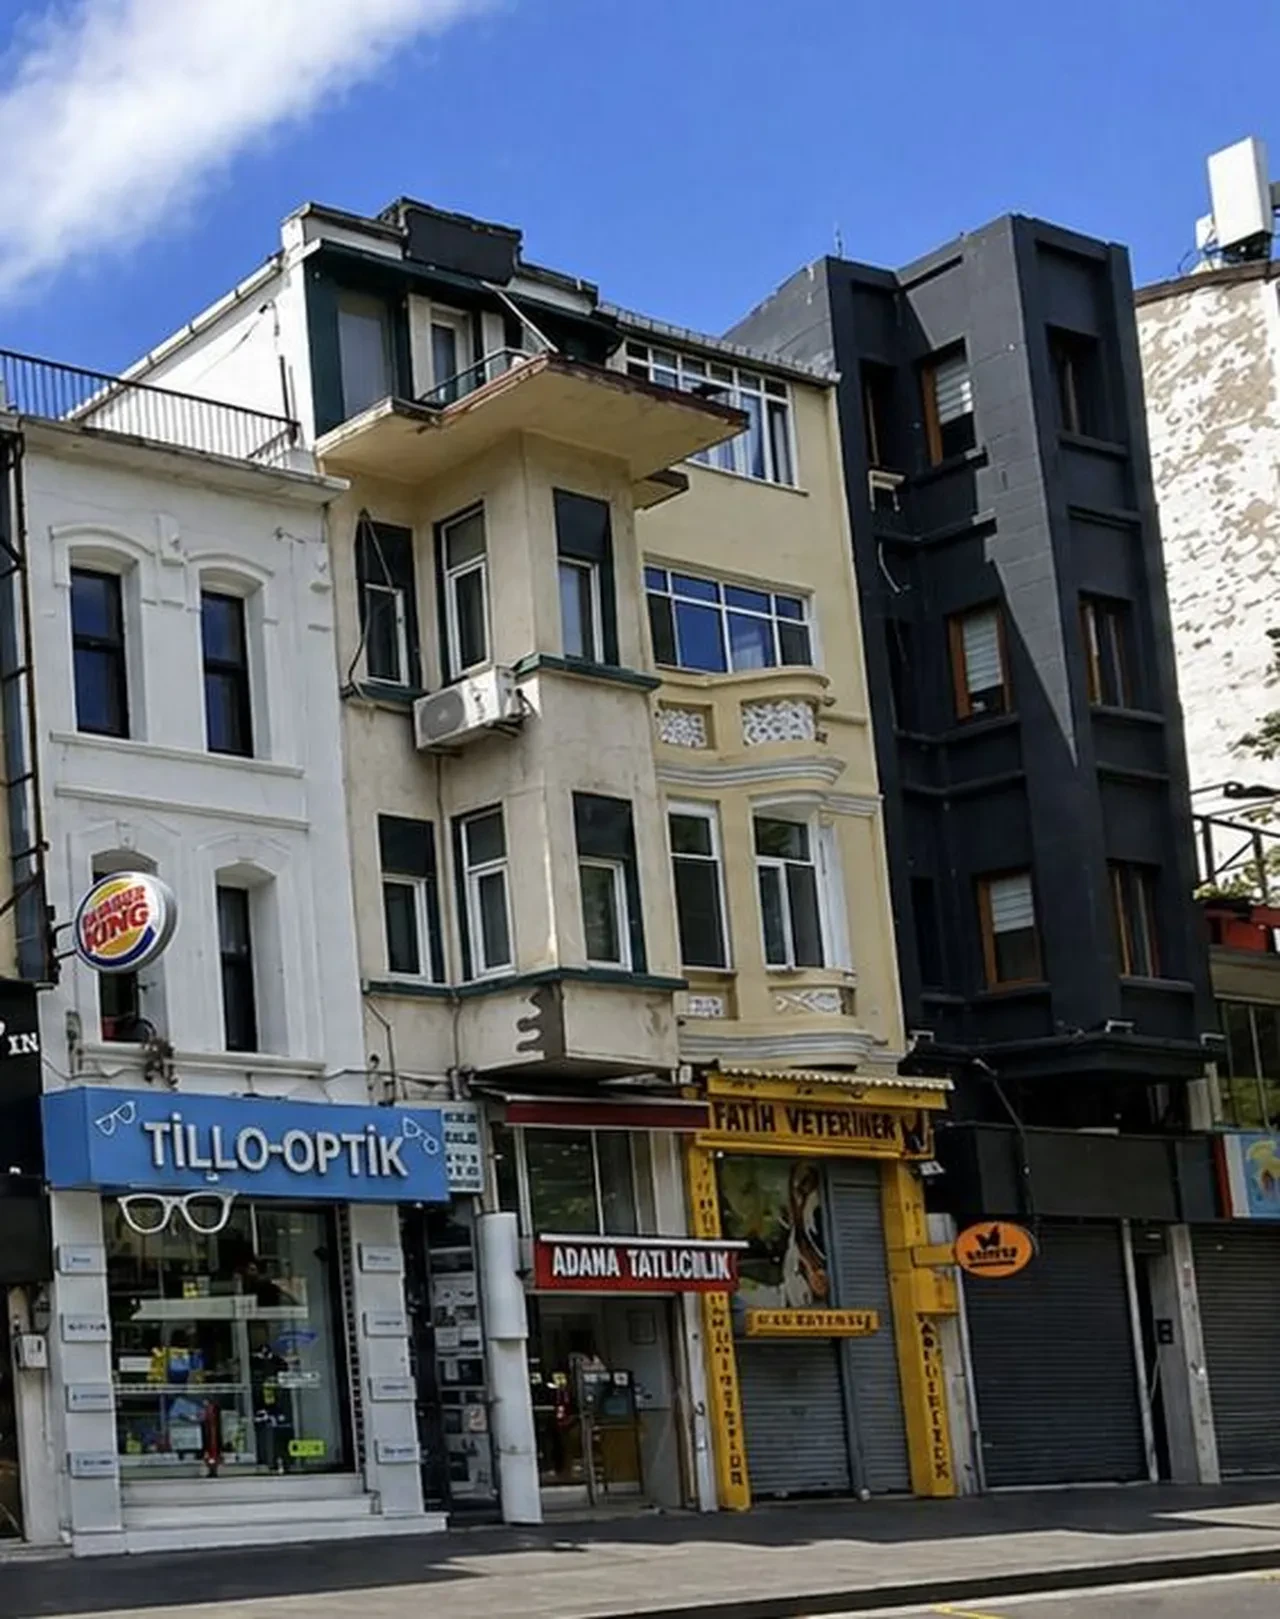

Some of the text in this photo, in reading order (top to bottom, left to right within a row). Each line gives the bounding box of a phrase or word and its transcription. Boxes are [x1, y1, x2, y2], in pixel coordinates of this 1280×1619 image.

[84, 903, 149, 953] KING
[144, 1112, 410, 1179] TİLLO-OPTİK
[552, 1246, 620, 1277] ADANA
